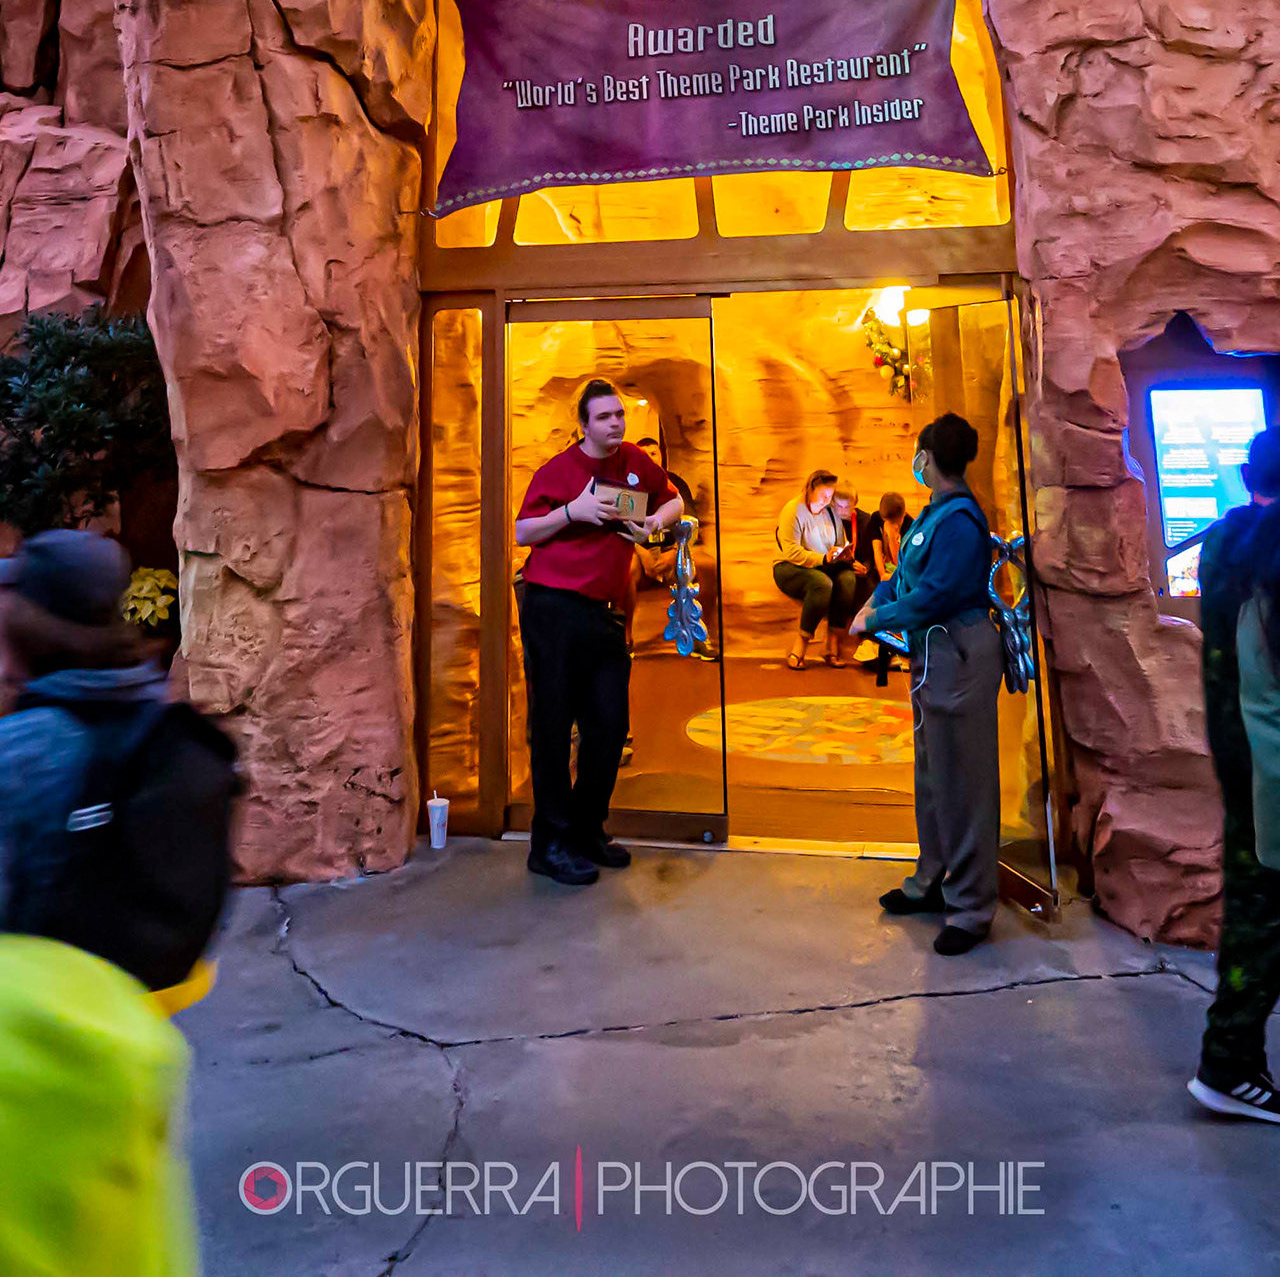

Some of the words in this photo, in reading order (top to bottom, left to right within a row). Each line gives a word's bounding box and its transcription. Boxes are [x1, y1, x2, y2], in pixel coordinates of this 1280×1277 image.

[628, 14, 775, 57] Awarded
[502, 76, 597, 108] "World's
[603, 75, 650, 102] Best
[656, 69, 724, 99] Theme
[728, 64, 780, 92] Park
[786, 43, 927, 87] Restaurant"
[727, 111, 798, 136] -Theme
[803, 105, 850, 131] Park
[853, 98, 924, 126] Insider
